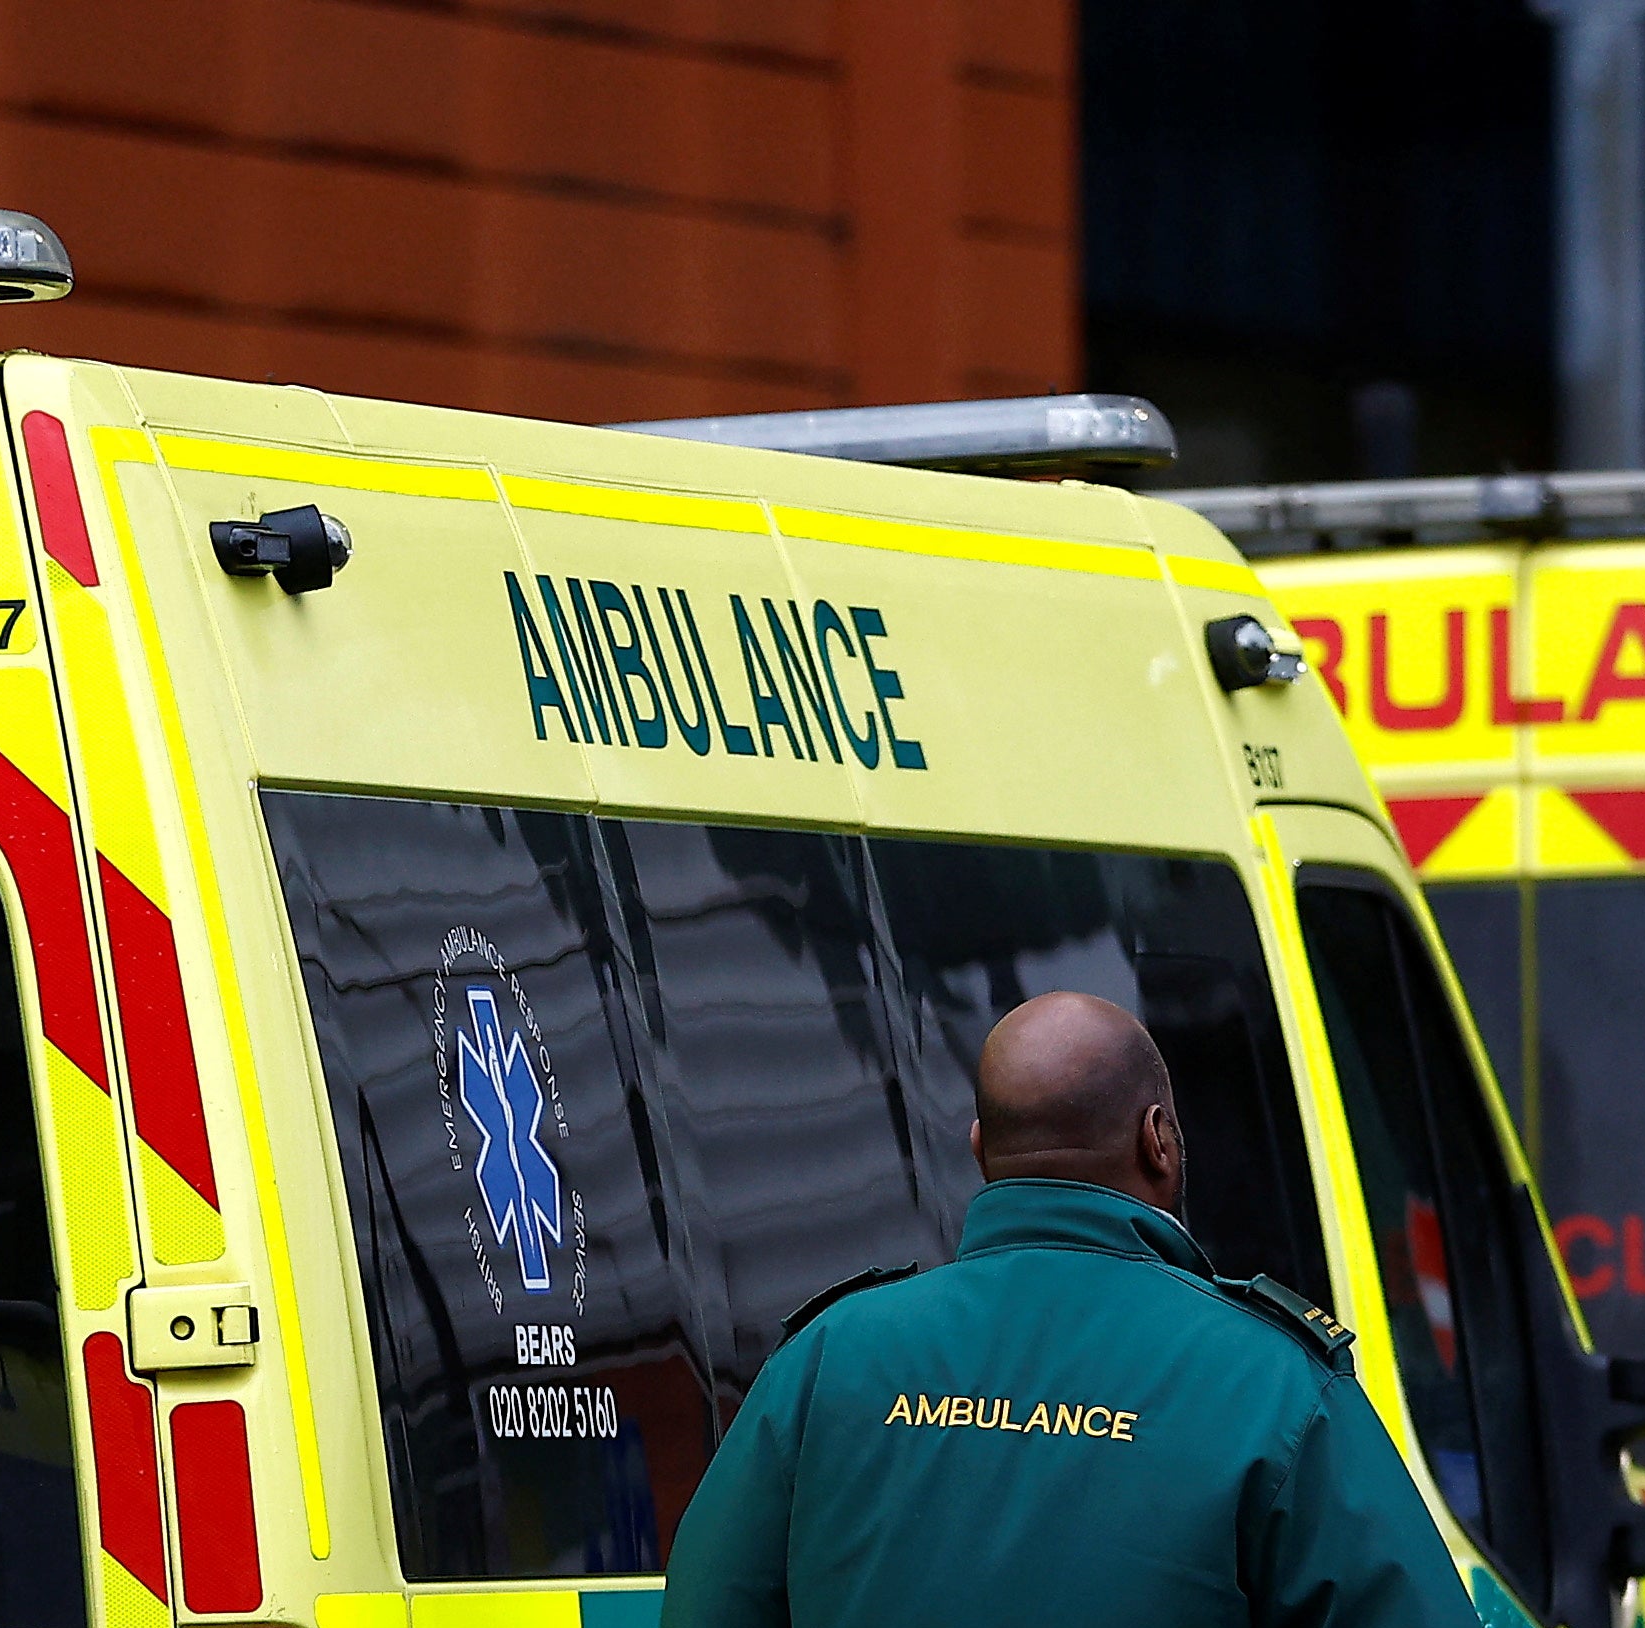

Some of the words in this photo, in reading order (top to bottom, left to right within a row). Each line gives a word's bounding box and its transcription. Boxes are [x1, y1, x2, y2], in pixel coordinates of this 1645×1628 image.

[503, 570, 927, 770] AMBULANCE
[440, 925, 507, 982] AMBULANCE
[433, 969, 463, 1171] EMERGENCY
[510, 972, 571, 1140] RESPONSE
[464, 1207, 503, 1315] BRITISH
[571, 1190, 587, 1317] SERVICE
[515, 1325, 576, 1366] BEARS
[489, 1386, 524, 1438] 020
[526, 1386, 572, 1438] 8202
[573, 1386, 618, 1438] 5160
[884, 1393, 1138, 1442] AMBULANCE
